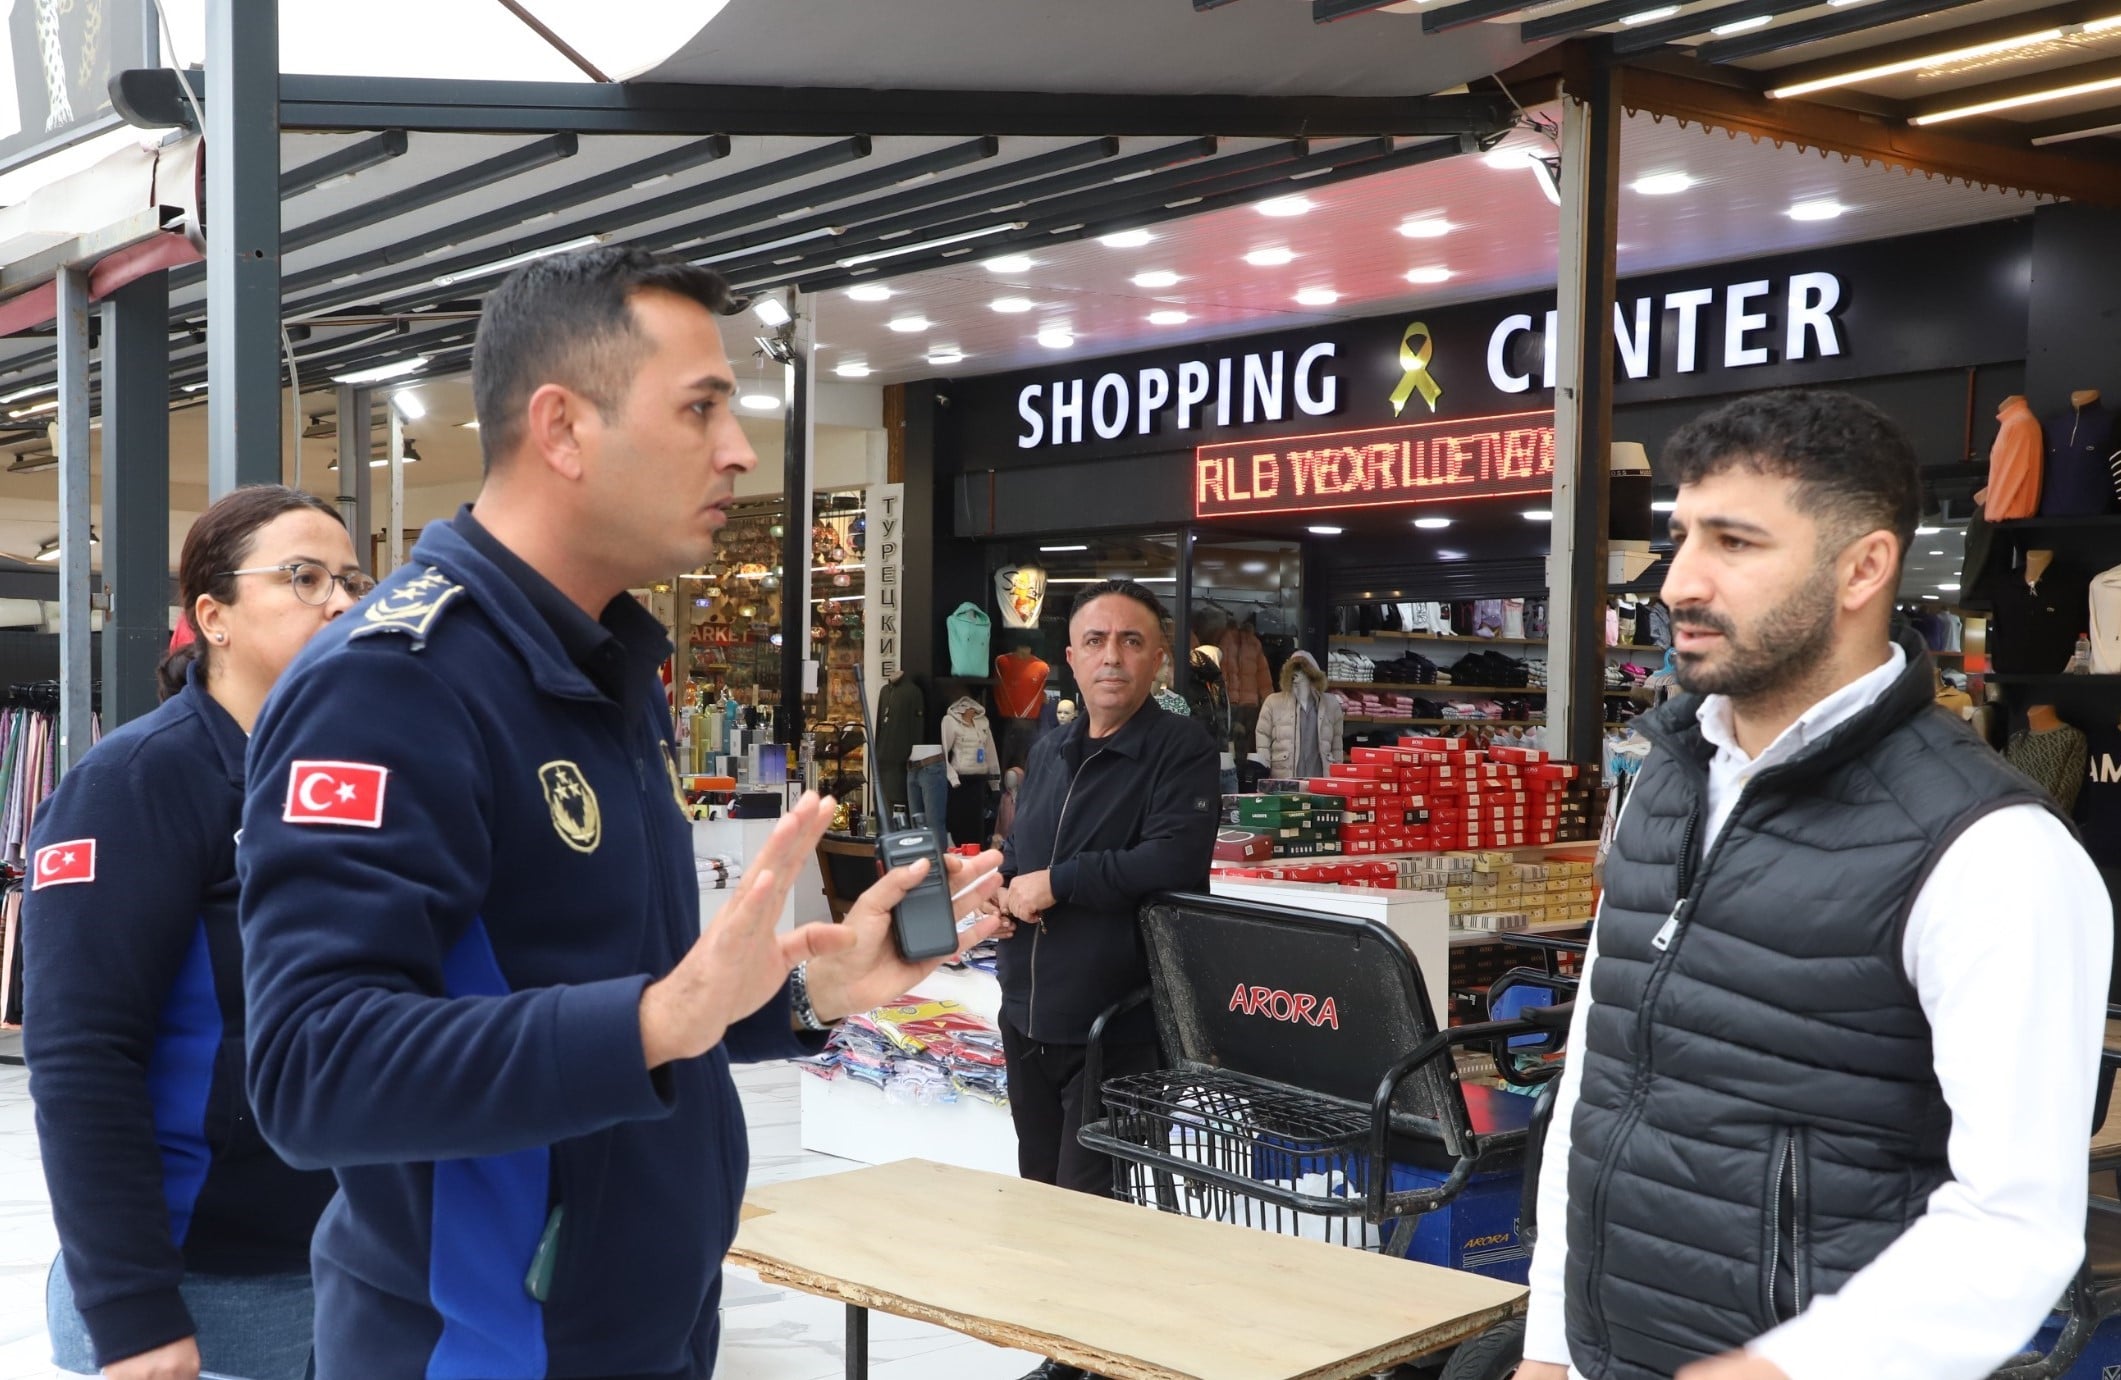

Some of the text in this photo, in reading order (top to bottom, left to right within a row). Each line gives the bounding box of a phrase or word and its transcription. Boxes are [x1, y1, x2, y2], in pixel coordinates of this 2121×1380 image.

[1017, 341, 1338, 449] SHOPPING
[1229, 983, 1338, 1030] ARORA
[1464, 1234, 1509, 1248] ARORA
